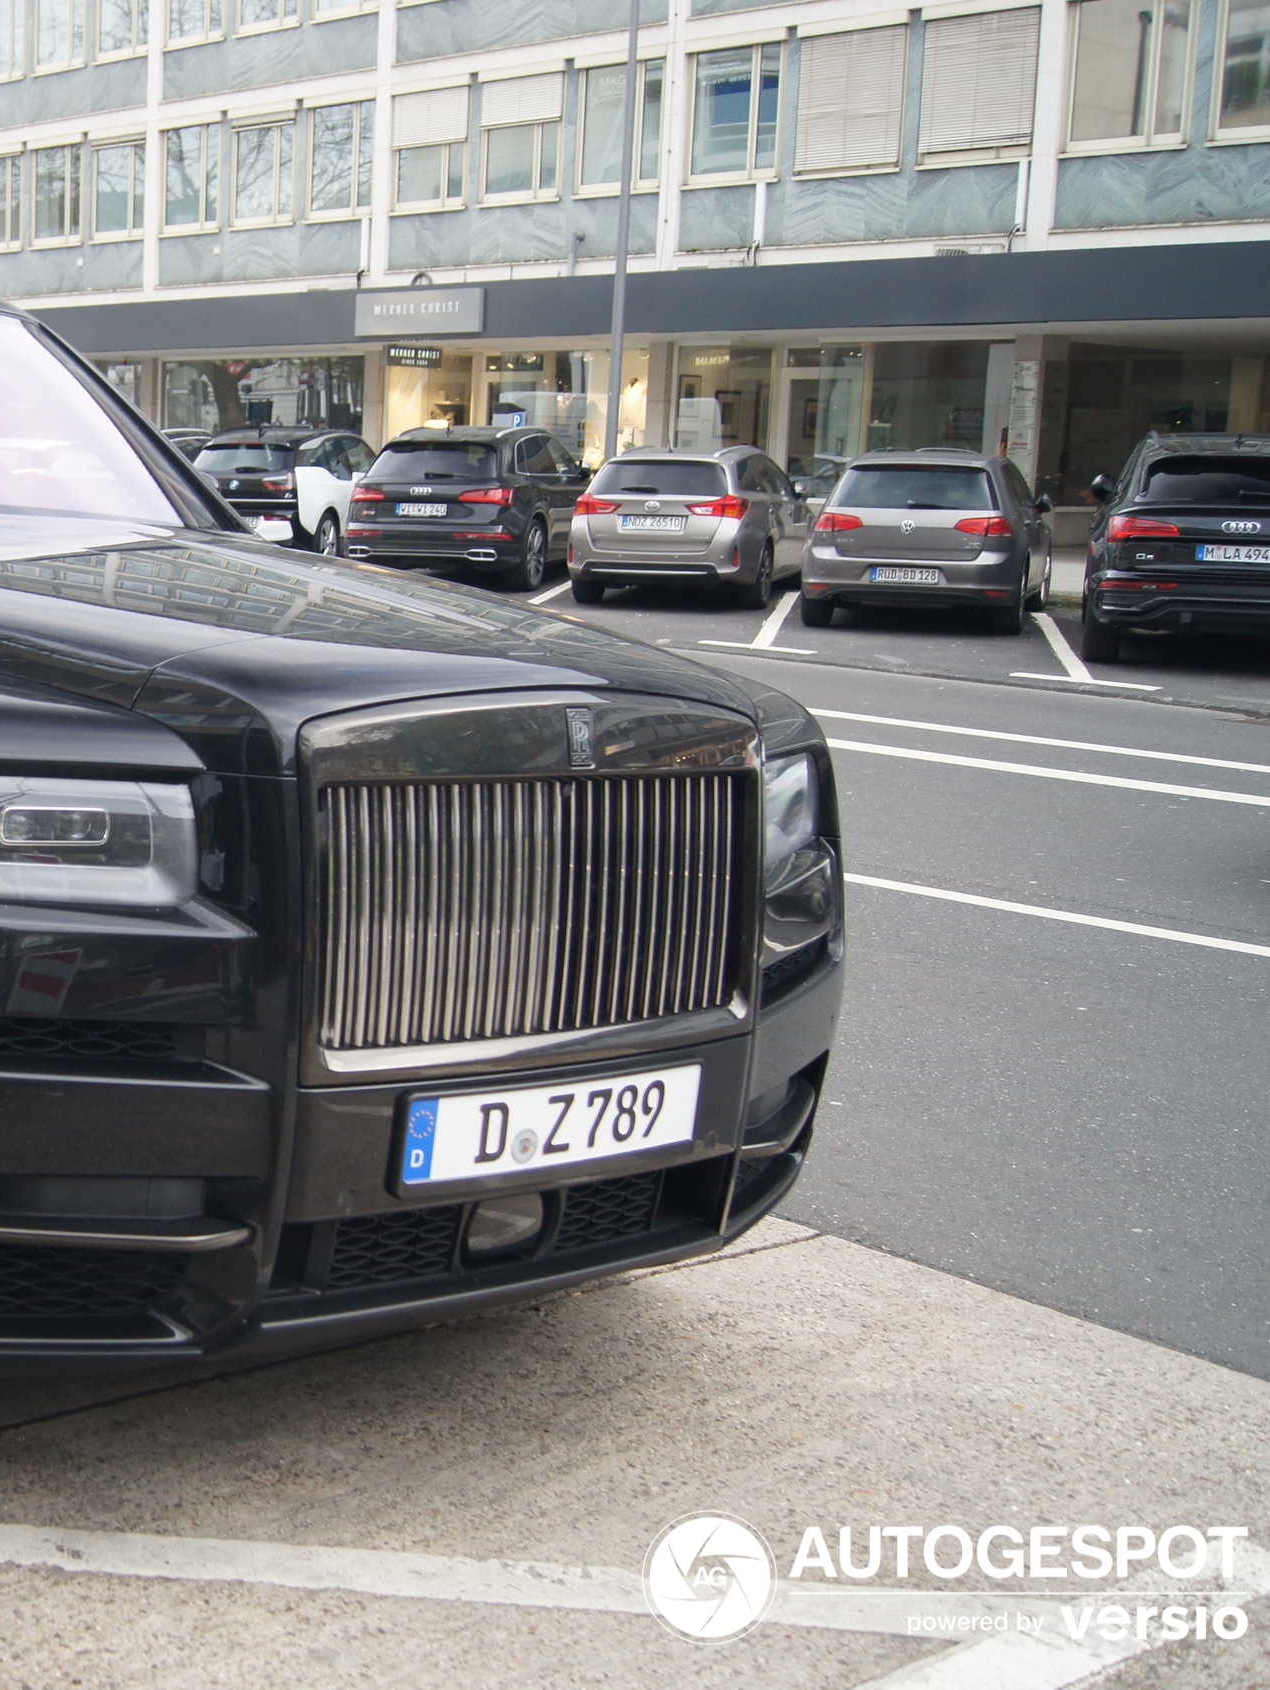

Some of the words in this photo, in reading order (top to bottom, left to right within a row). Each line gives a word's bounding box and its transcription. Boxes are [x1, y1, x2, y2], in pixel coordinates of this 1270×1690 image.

[373, 303, 415, 316] WERNER
[421, 301, 460, 314] CHRIST
[389, 348, 415, 358] WERNER
[513, 414, 521, 428] P
[401, 505, 411, 513] WI
[417, 505, 427, 513] WI
[429, 505, 446, 514] 240
[628, 516, 647, 527] NDZ
[650, 517, 681, 528] 26510
[1205, 547, 1214, 559] M
[1223, 548, 1241, 560] LA
[1244, 548, 1269, 561] 494
[877, 568, 897, 580] RÜD
[903, 570, 916, 580] BD
[918, 570, 937, 581] 128
[474, 1102, 510, 1164] D
[542, 1093, 575, 1155] Z
[587, 1080, 665, 1148] 789
[410, 1149, 424, 1168] D
